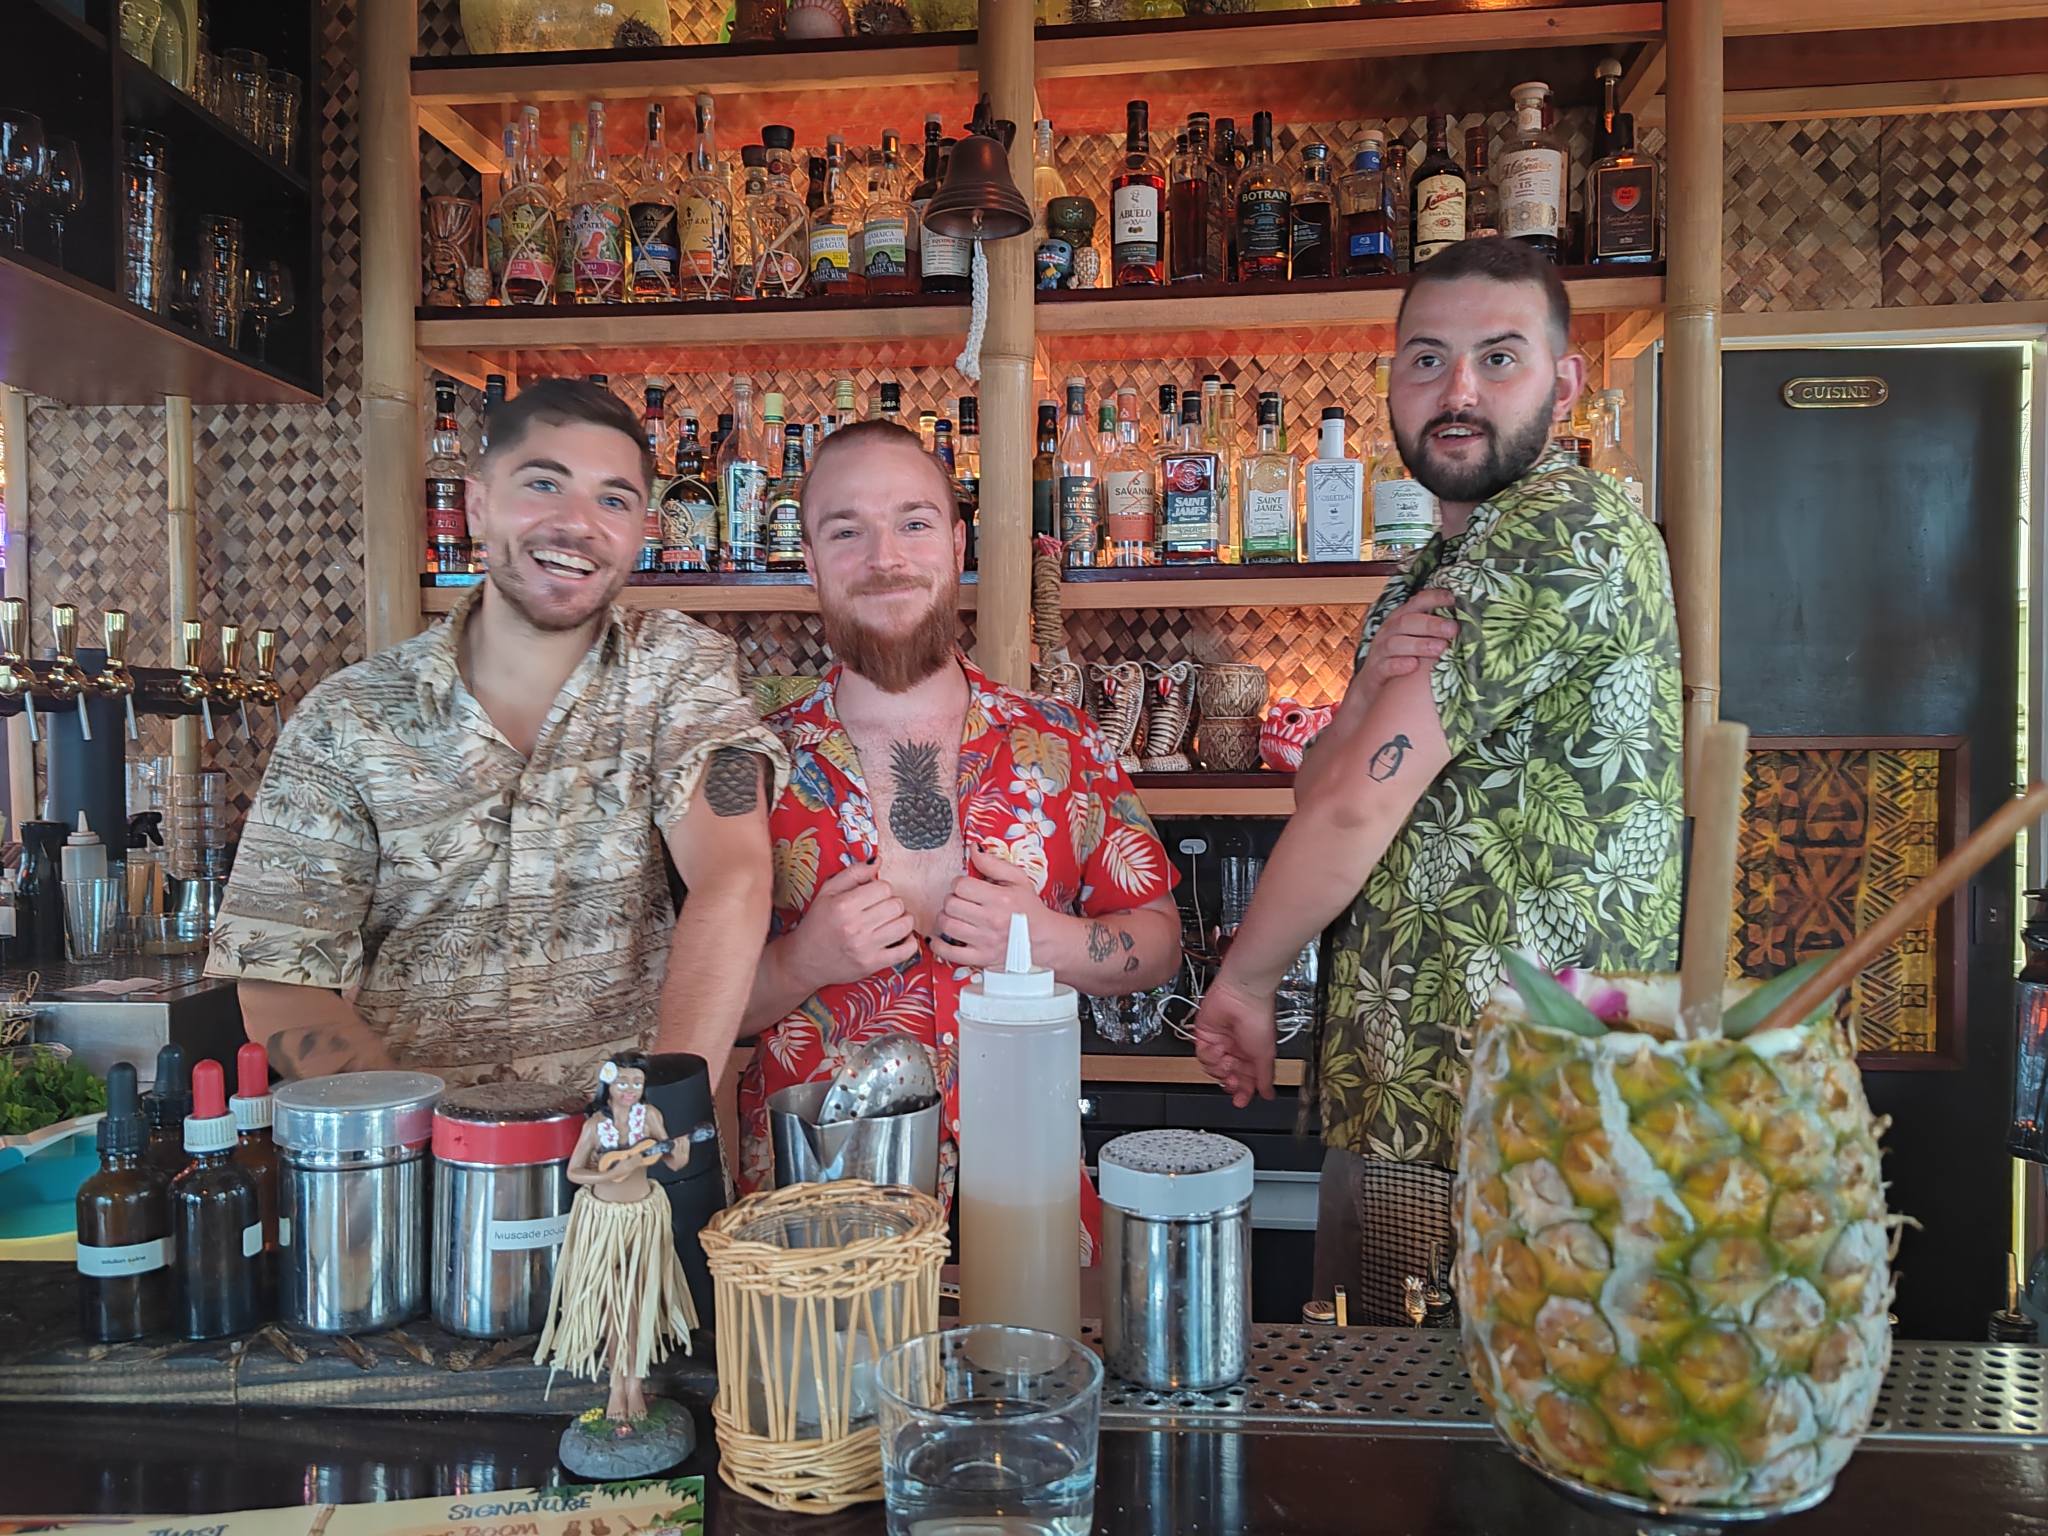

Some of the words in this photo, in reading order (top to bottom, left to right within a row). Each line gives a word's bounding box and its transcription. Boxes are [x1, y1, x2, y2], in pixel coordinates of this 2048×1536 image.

[1242, 190, 1287, 202] BOTRAN
[1120, 209, 1152, 219] ABUELO
[1802, 386, 1871, 399] CUISINE
[1174, 497, 1207, 507] SAINT
[1257, 496, 1282, 504] SAINT
[1172, 506, 1208, 517] JAMES
[1255, 504, 1283, 512] JAMES
[495, 1230, 540, 1240] Muscade
[448, 1496, 592, 1520] SIGNATURE
